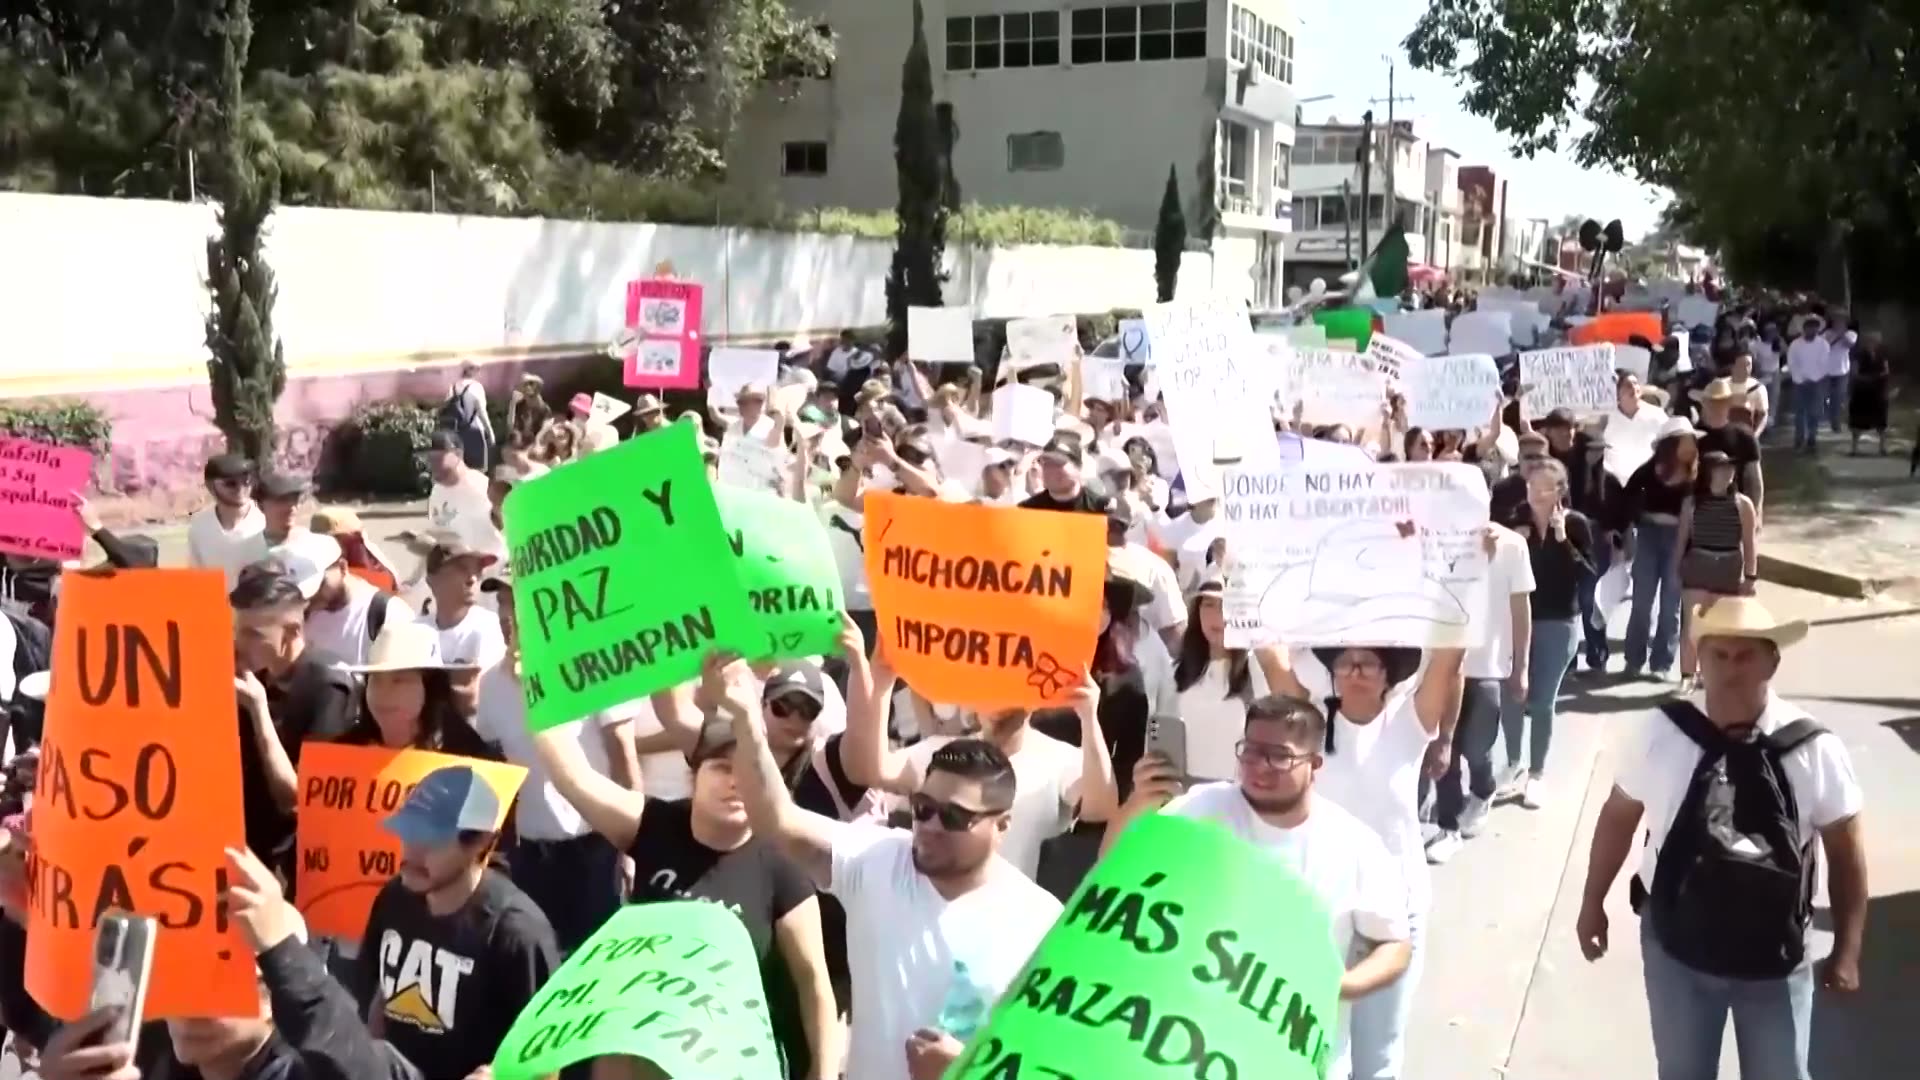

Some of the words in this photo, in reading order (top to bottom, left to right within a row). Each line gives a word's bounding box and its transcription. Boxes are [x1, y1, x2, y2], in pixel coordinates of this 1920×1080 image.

[642, 479, 676, 527] Y
[1305, 472, 1331, 493] NO
[1338, 472, 1375, 492] HAY
[1224, 503, 1242, 522] NO
[1249, 503, 1279, 521] HAY
[883, 544, 1073, 600] MICHOACÁN
[532, 566, 635, 643] PAZ
[77, 620, 181, 709] UN
[559, 605, 716, 692] URUAPAN
[896, 615, 1034, 670] IMPORTA
[40, 740, 177, 820] PASO
[305, 776, 356, 810] POR
[1065, 871, 1185, 954] MÁS
[379, 928, 475, 1030] CAT
[579, 933, 673, 968] POR
[518, 1006, 629, 1064] QUE
